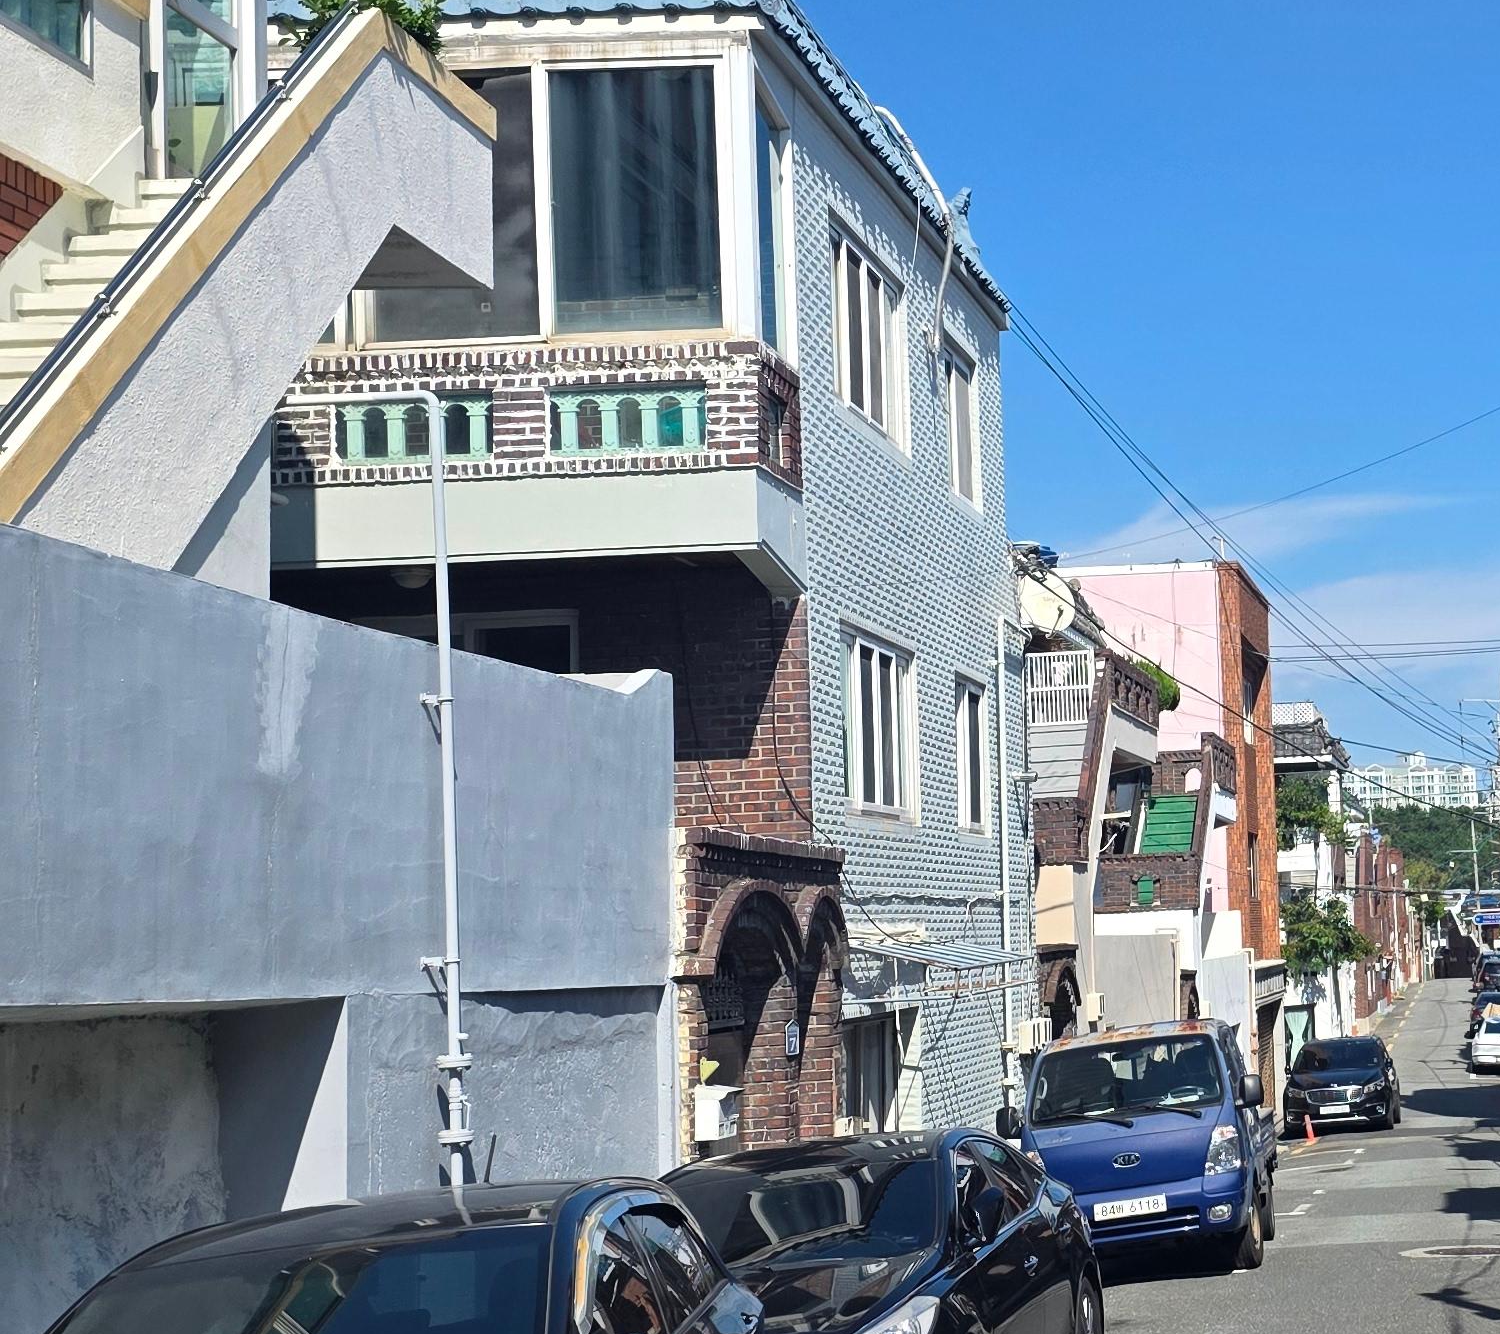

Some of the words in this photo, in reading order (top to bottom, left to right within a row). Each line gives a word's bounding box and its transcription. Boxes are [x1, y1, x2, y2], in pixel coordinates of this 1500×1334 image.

[789, 1037, 797, 1052] 7
[1117, 1154, 1137, 1165] KIA
[1130, 1199, 1160, 1213] 6118
